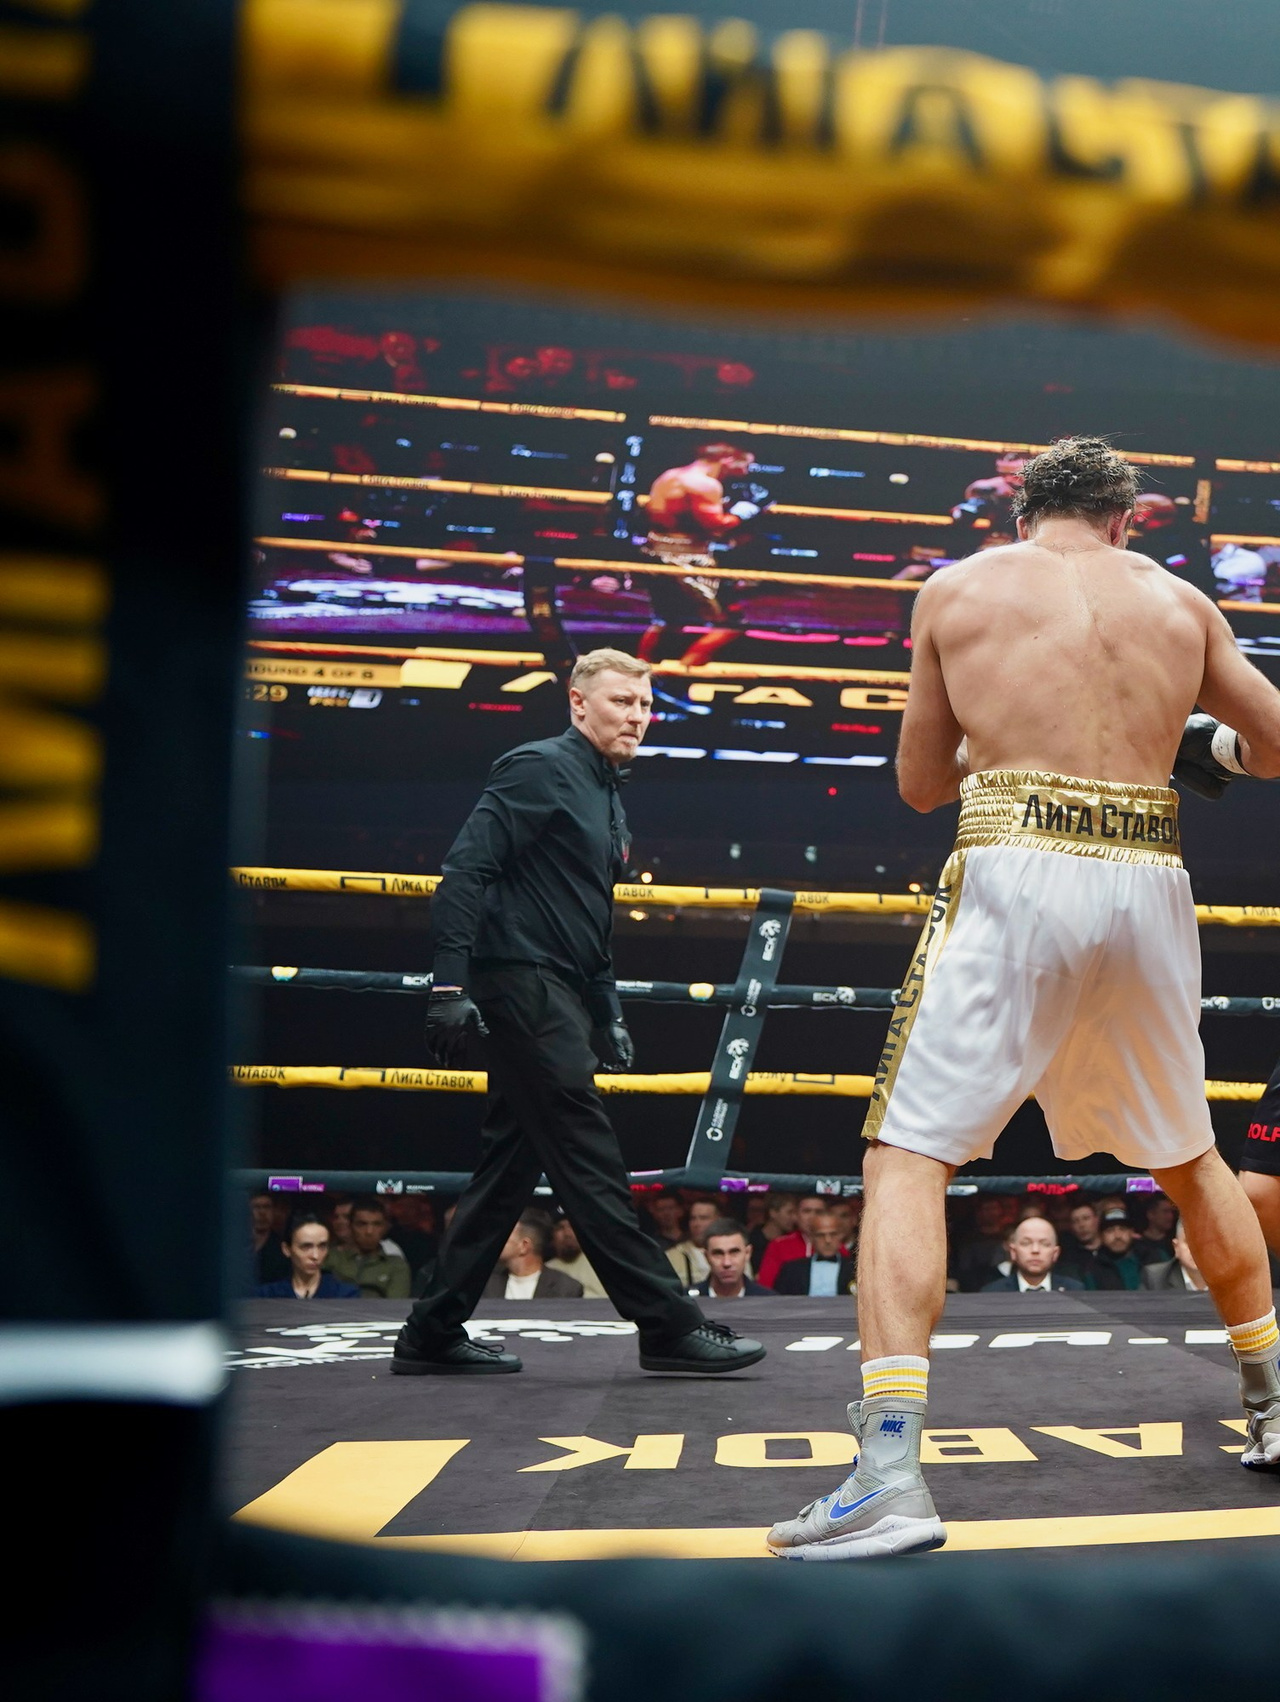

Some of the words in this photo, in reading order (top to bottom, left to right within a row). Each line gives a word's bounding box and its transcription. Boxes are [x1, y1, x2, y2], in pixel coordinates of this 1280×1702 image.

[1021, 794, 1094, 836] ЛИГА
[617, 887, 655, 898] ТАВОК
[391, 1071, 423, 1086] ЛИГА
[426, 1072, 475, 1090] СТАВОК
[880, 1420, 906, 1433] NIKE
